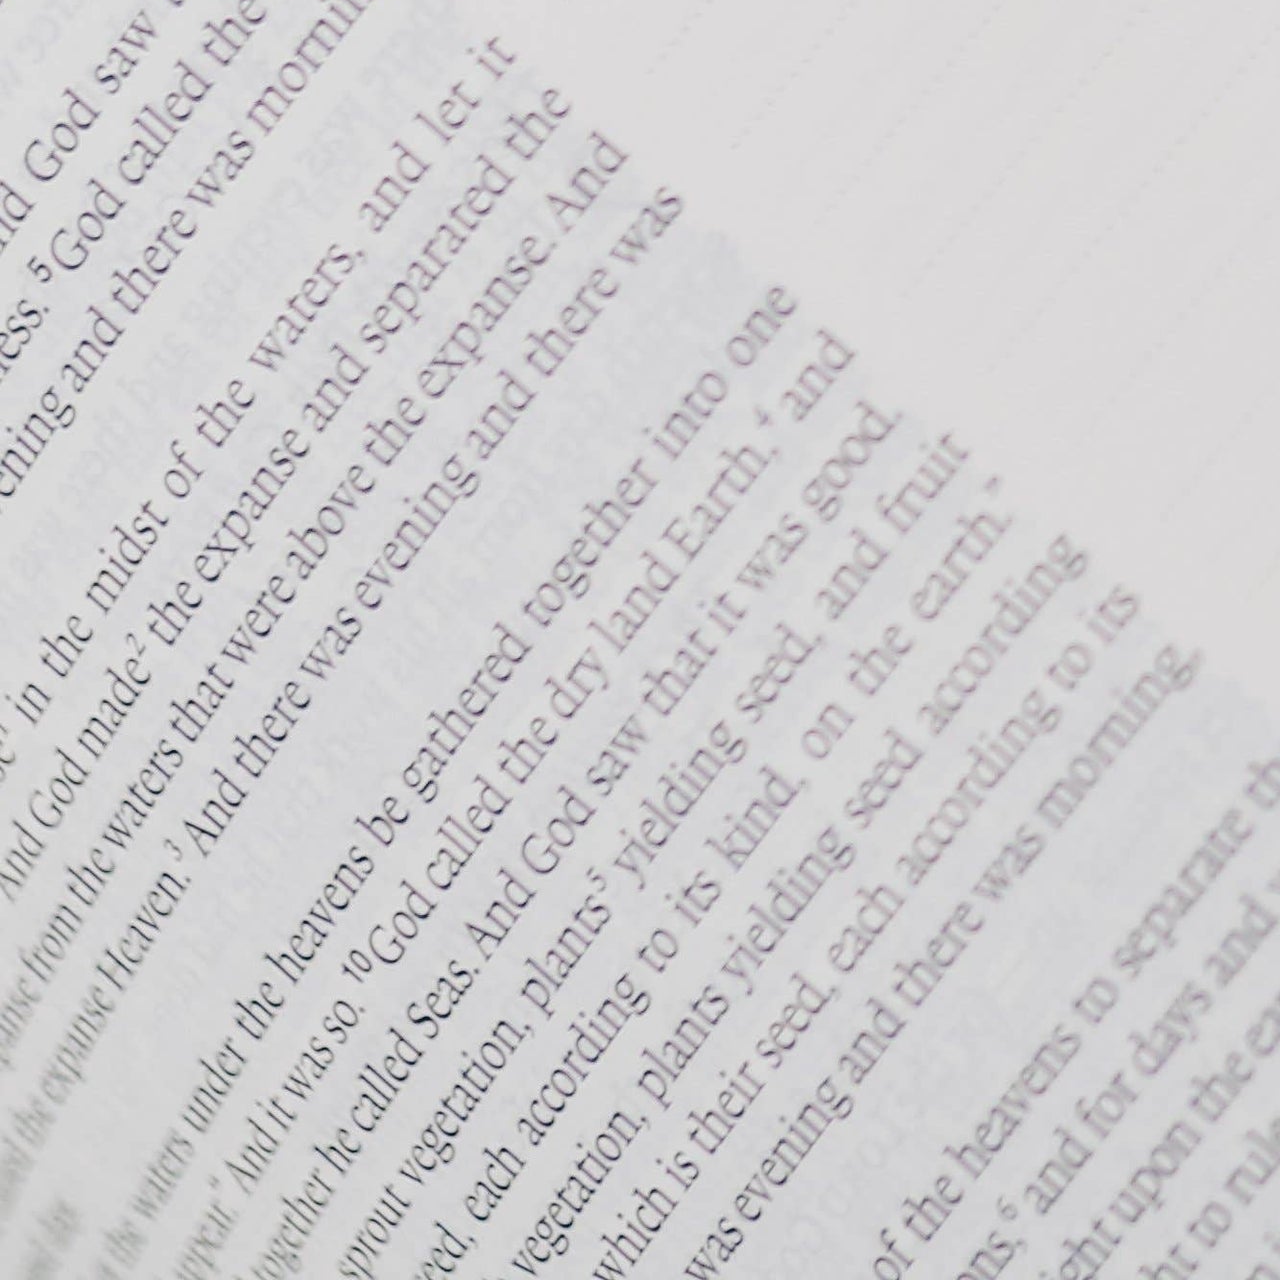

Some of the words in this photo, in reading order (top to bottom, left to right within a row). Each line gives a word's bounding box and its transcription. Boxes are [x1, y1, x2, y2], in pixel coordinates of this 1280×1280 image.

[14, 682, 52, 724] in
[39, 614, 93, 678] the
[85, 499, 169, 615] midst
[163, 438, 204, 499] of
[195, 379, 256, 448] the
[359, 139, 431, 233] and
[413, 80, 481, 145] let
[466, 36, 516, 81] it
[23, 87, 100, 182] God
[93, 10, 156, 95] saw
[60, 304, 125, 393] and
[111, 208, 197, 315] there
[185, 129, 254, 207] was
[117, 59, 214, 186] called
[20, 903, 83, 982] from
[66, 847, 115, 906] the
[101, 738, 183, 849] waters
[168, 662, 234, 743] that
[219, 574, 296, 664] were
[285, 463, 375, 581] above
[363, 396, 426, 467] the
[545, 130, 628, 233] And
[29, 747, 90, 828] God
[147, 580, 203, 646] the
[193, 428, 310, 583] expanse
[301, 342, 370, 433] and
[359, 153, 515, 355] separated
[502, 87, 571, 161] the
[181, 1042, 246, 1133] under
[234, 981, 285, 1040] the
[263, 845, 374, 984] heavens
[354, 795, 410, 847] be
[401, 621, 533, 804] gathered
[521, 457, 658, 629] together
[641, 370, 728, 461] into
[725, 285, 797, 367] one
[183, 767, 248, 857] And
[232, 680, 311, 778] there
[298, 605, 362, 680] was
[354, 452, 480, 611] evening
[465, 368, 537, 461] and
[524, 267, 619, 378] there
[608, 185, 683, 264] was
[611, 719, 747, 891] yielding
[816, 527, 891, 621] and
[875, 432, 970, 536] fruit
[224, 1116, 279, 1181] And
[265, 1097, 297, 1131] it
[282, 1035, 334, 1100] was
[426, 773, 512, 891] called
[497, 716, 559, 785] the
[542, 646, 609, 721] dry
[586, 549, 681, 654] land
[781, 328, 856, 422] and
[312, 1127, 361, 1174] he
[351, 1026, 425, 1132] called
[464, 867, 537, 961] And
[520, 784, 597, 875] God
[585, 713, 646, 798] saw
[641, 628, 718, 717] that
[697, 591, 747, 636] it
[734, 512, 809, 590] was
[465, 1146, 526, 1222] each
[516, 972, 651, 1147] according
[636, 927, 678, 973] to
[664, 869, 721, 927] its
[801, 702, 855, 760] on
[846, 624, 914, 697] the
[636, 984, 730, 1111] plants
[719, 824, 855, 997] yielding
[843, 727, 925, 830] seed
[916, 533, 1089, 738] according
[655, 1150, 700, 1191] is
[686, 1060, 766, 1155] their
[827, 884, 906, 974] each
[894, 687, 1063, 888] according
[1044, 641, 1092, 692] to
[1086, 585, 1140, 644] its
[732, 1075, 854, 1223] evening
[838, 996, 907, 1085] and
[890, 901, 985, 1008] there
[970, 823, 1045, 901] was
[901, 1174, 964, 1243] the
[941, 1024, 1081, 1181] heavens
[1070, 975, 1119, 1025] to
[1111, 806, 1254, 979] separate
[1023, 1125, 1094, 1216] and
[1074, 1069, 1139, 1140] for
[1126, 980, 1214, 1078] days
[1203, 892, 1280, 990] and
[1107, 1119, 1203, 1226] upon
[1186, 1050, 1256, 1123] the
[1184, 1200, 1232, 1250] to
